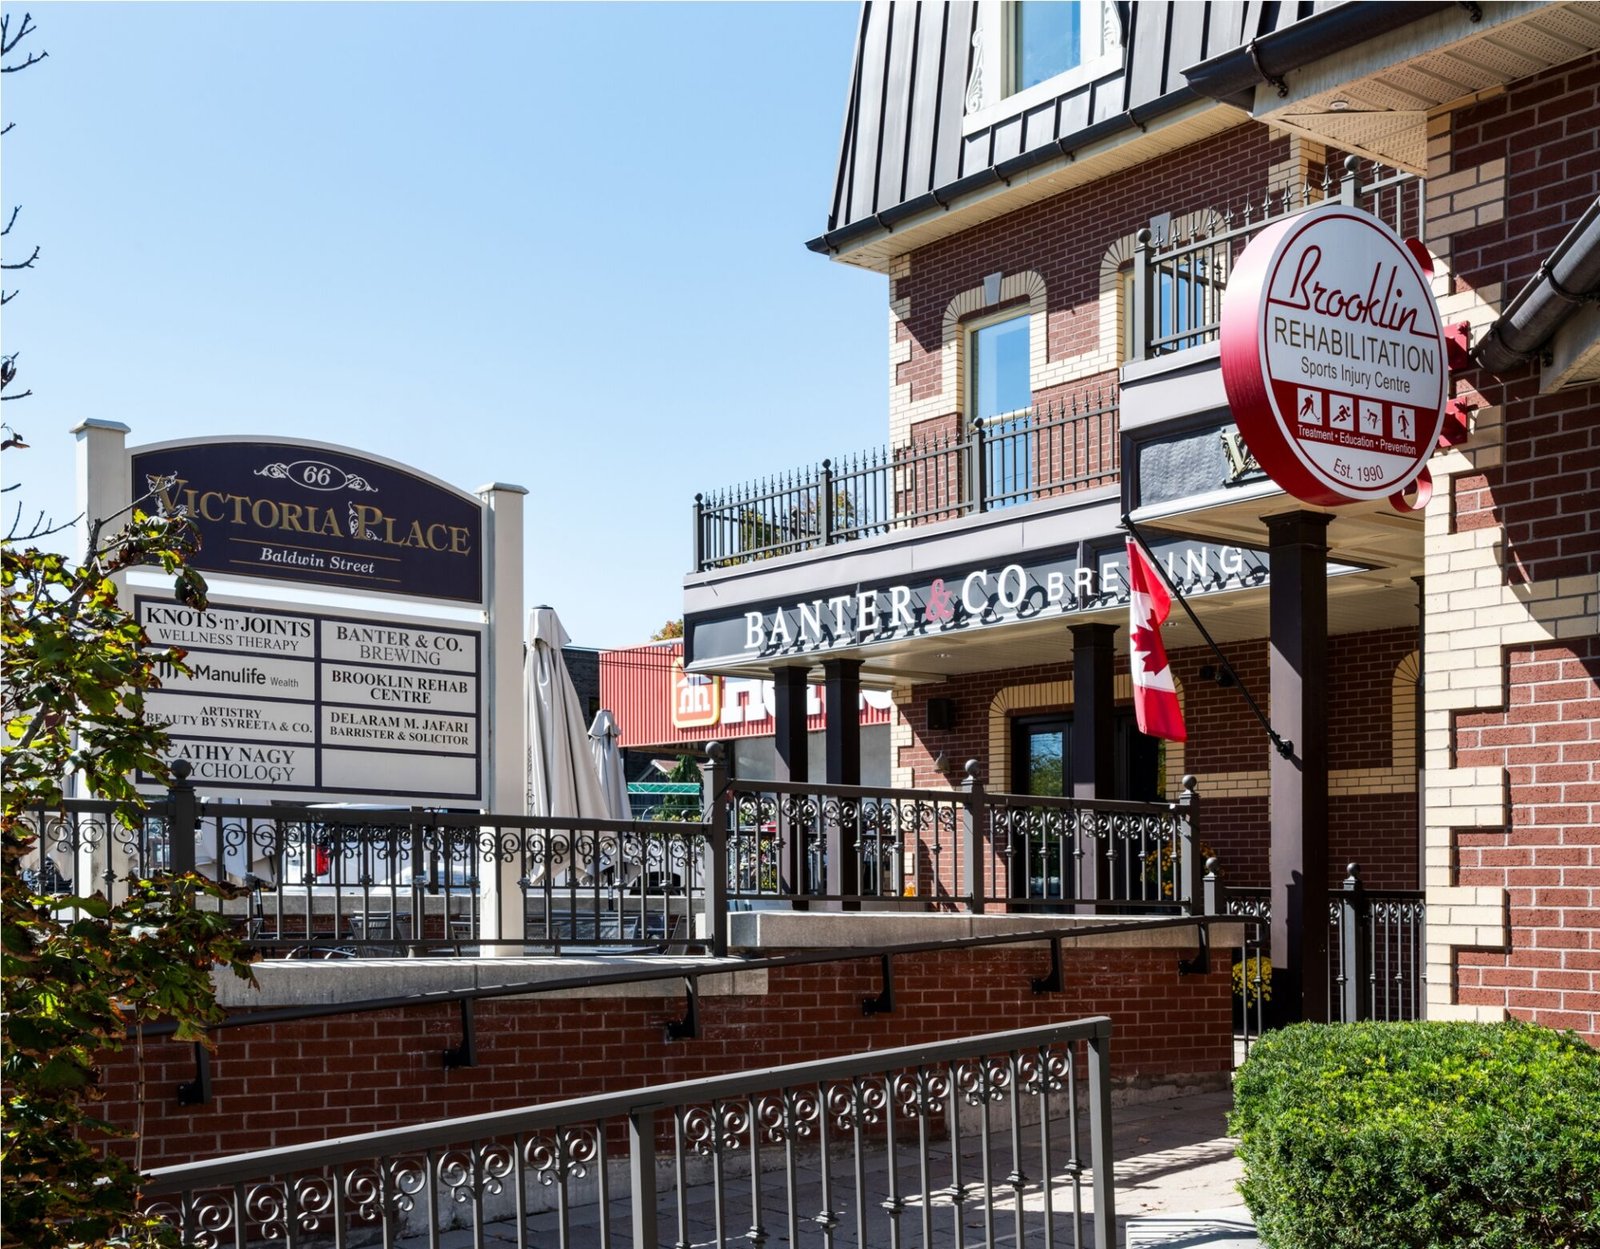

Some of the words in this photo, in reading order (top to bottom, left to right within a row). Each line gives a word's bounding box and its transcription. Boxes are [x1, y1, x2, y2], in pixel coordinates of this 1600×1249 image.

[1269, 245, 1438, 338] Brooklin
[1274, 316, 1434, 375] REHABILITATION
[1301, 356, 1337, 379] Sports
[1341, 364, 1371, 390] Injury
[1374, 371, 1411, 394] Centre
[1297, 424, 1334, 441] Treatment
[1339, 433, 1374, 448] Education
[1380, 438, 1416, 455] Prevention
[303, 466, 332, 486] 66
[1333, 458, 1353, 480] Est.
[1357, 464, 1384, 481] 1990
[149, 474, 345, 538] VICTORIA
[352, 504, 472, 557] PLACE
[260, 547, 325, 568] Baldwin
[330, 556, 375, 574] Street
[744, 585, 915, 649] BANTER
[925, 578, 955, 622] &
[962, 564, 1027, 615] CO
[1047, 545, 1243, 601] BREING
[147, 607, 217, 629] KNOTS
[240, 616, 311, 638] JOINTS
[159, 628, 233, 646] WELLNESS
[236, 635, 299, 652] THERAPY
[336, 626, 410, 647] BANTER
[415, 634, 428, 648] &
[433, 636, 463, 652] CO.
[360, 645, 441, 666] BREWING
[195, 664, 266, 685] Manulife
[270, 677, 299, 688] Wealth
[332, 670, 413, 689] BROOKLIN
[418, 677, 468, 693] REHAB
[370, 688, 431, 704] CENTRE
[146, 712, 198, 725] BEAUTY
[201, 717, 218, 727] BY
[221, 719, 277, 731] SYREETA
[279, 723, 289, 732] &
[292, 722, 313, 733] CO.
[200, 706, 262, 719] ARTISTRY
[330, 712, 400, 728] DELARAM
[404, 718, 419, 730] M.
[422, 719, 469, 733] JAFARI
[330, 726, 395, 740] BARRISTER
[397, 731, 406, 741] &
[409, 732, 469, 745] SOLICITOR
[163, 743, 234, 761] CATHY
[239, 747, 295, 765] NAGY
